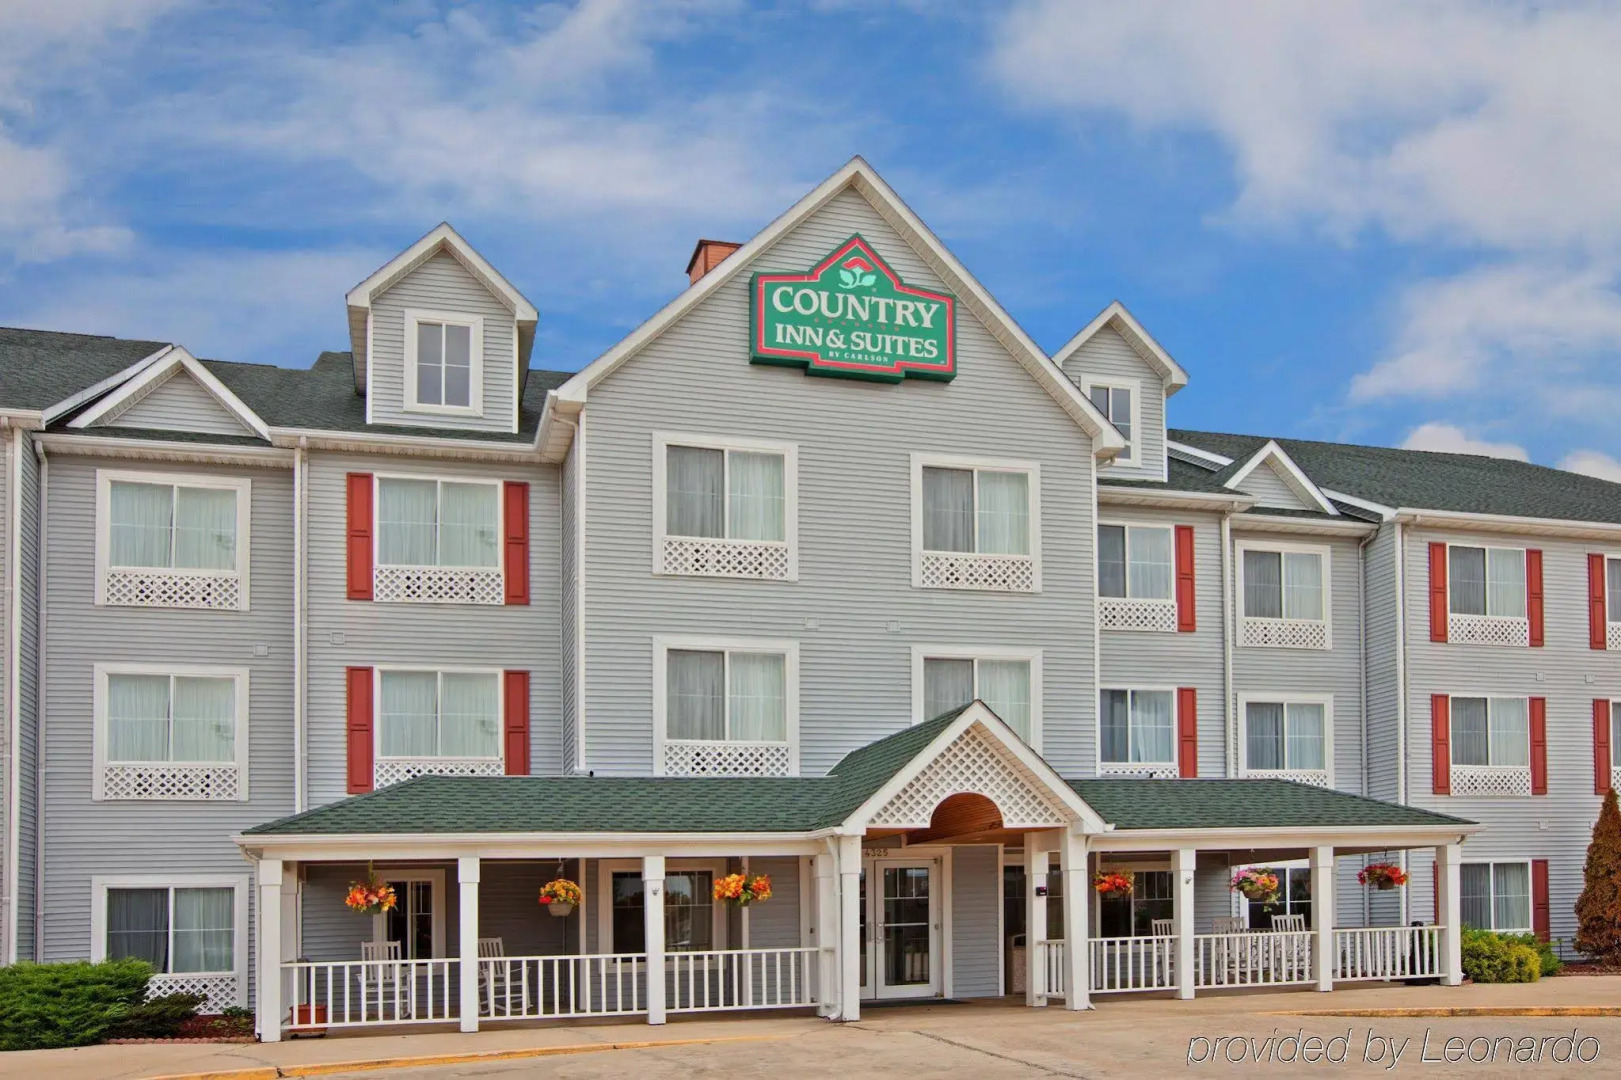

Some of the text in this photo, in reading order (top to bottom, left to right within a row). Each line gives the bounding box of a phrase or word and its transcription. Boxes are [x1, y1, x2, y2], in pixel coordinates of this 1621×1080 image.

[772, 286, 940, 328] COUNTRY
[775, 323, 938, 358] INN & SUITES
[844, 352, 888, 362] CARLSON
[864, 848, 888, 857] 4325
